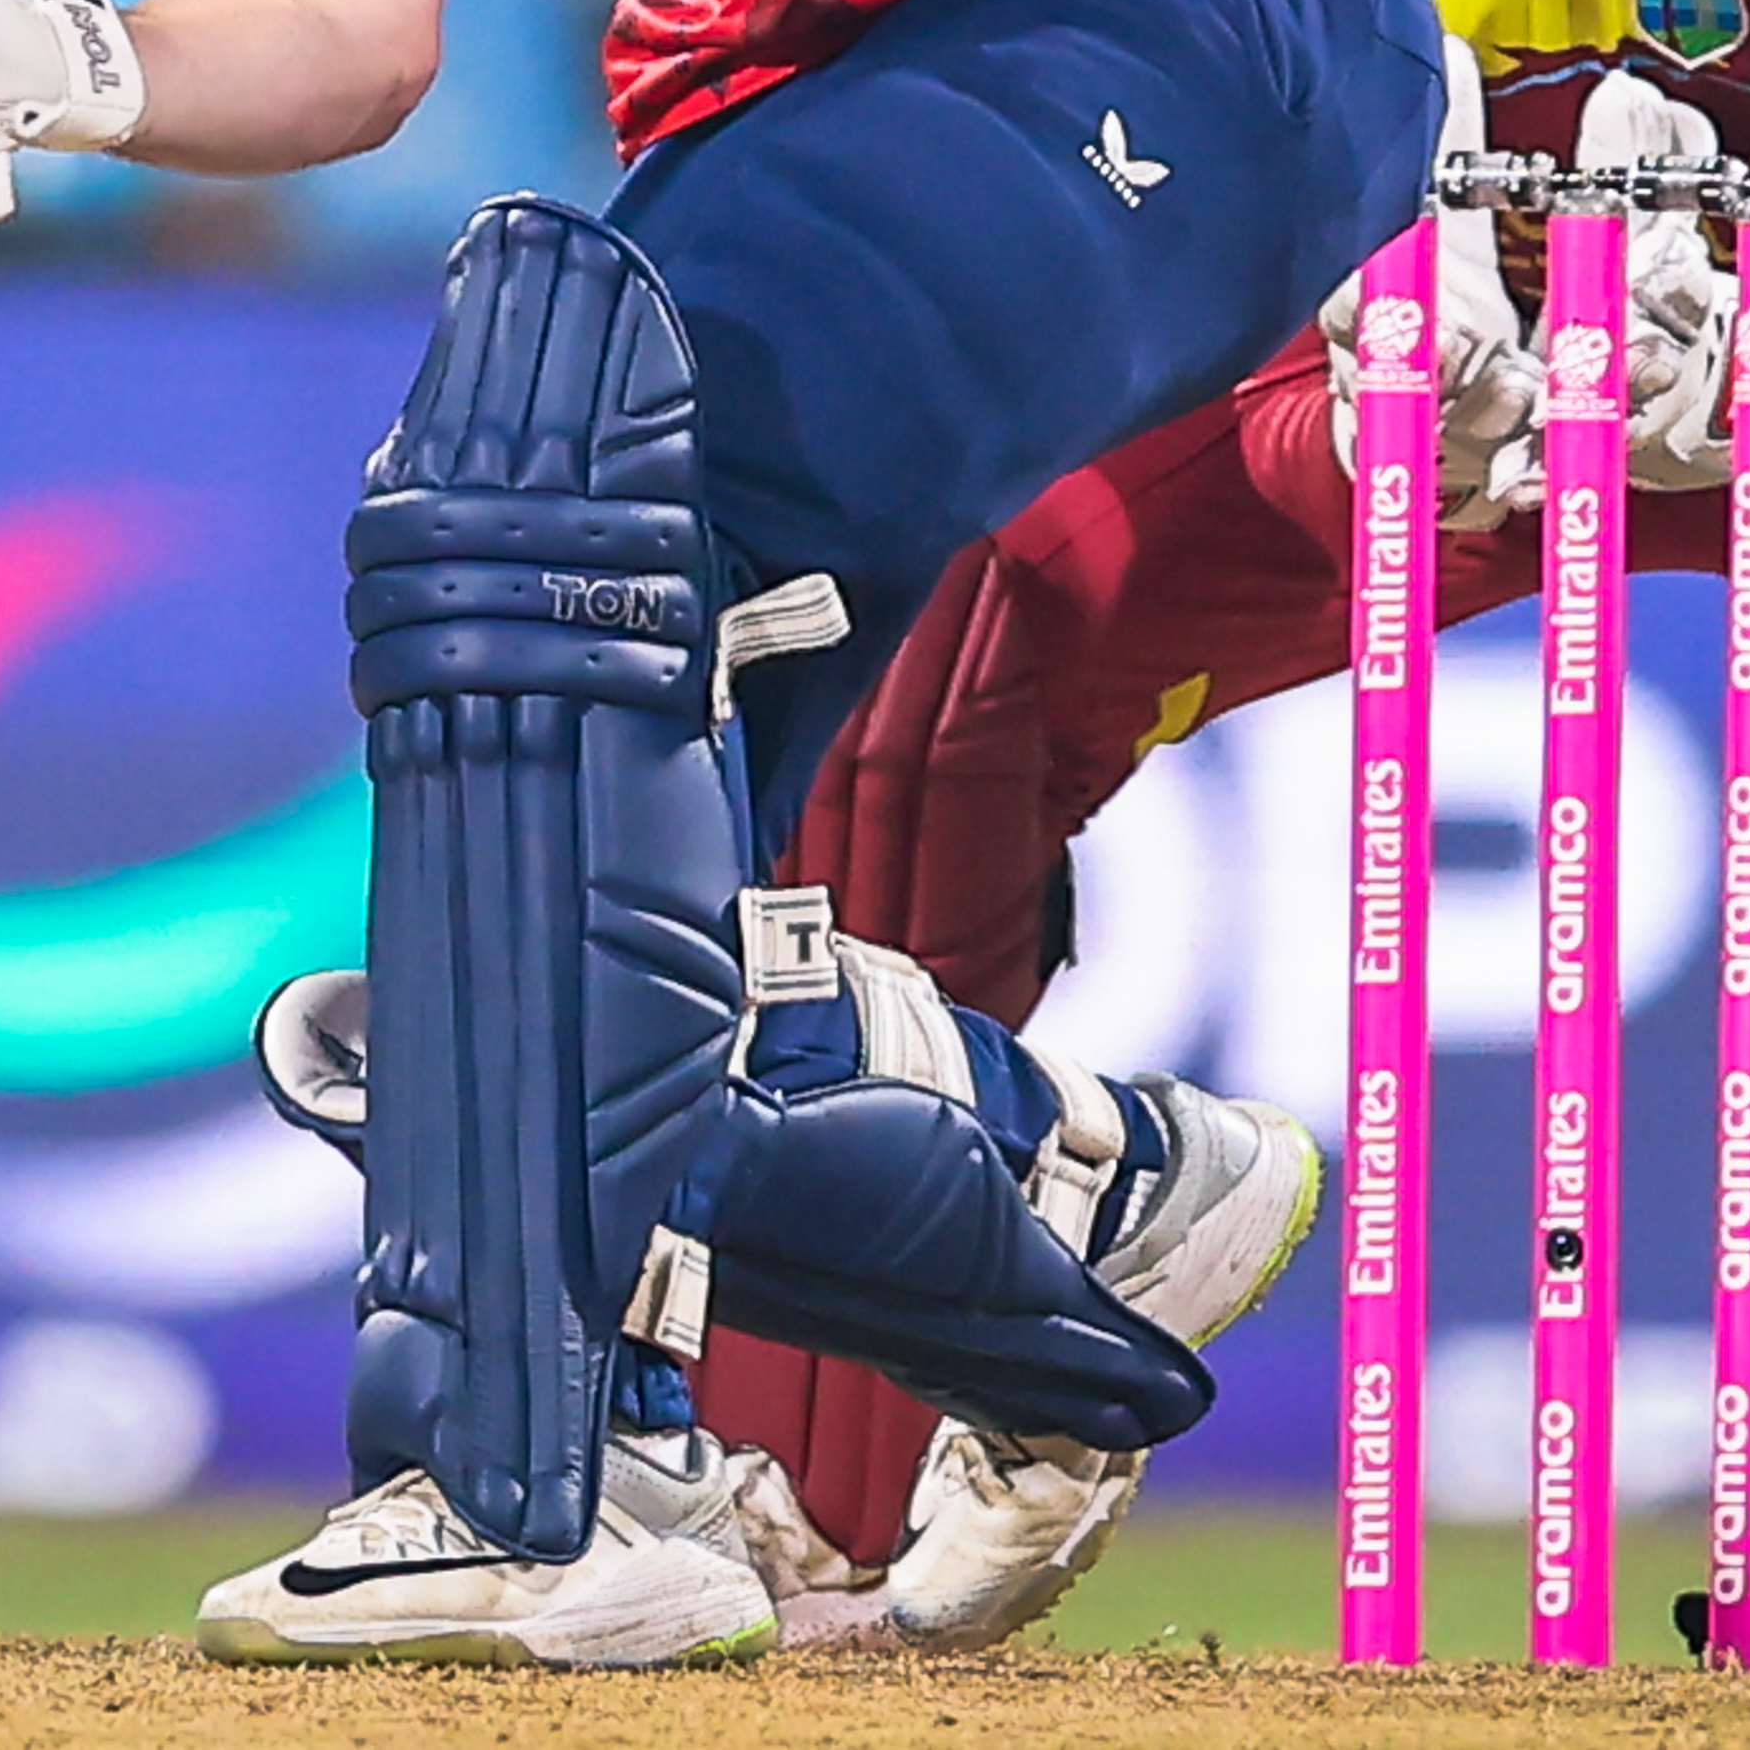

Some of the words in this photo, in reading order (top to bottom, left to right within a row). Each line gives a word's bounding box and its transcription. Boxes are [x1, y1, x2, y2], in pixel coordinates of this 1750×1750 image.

[542, 571, 665, 631] TON
[1359, 463, 1411, 692] Emirates
[1550, 487, 1599, 716] Emirates
[786, 921, 821, 963] T
[1355, 758, 1404, 984] Emirates
[1546, 797, 1588, 1014] aramco
[1349, 1068, 1397, 1296] Emirates
[1344, 1362, 1391, 1589] Emirates
[1536, 1400, 1577, 1617] aramco
[1712, 1383, 1749, 1604] aramco
